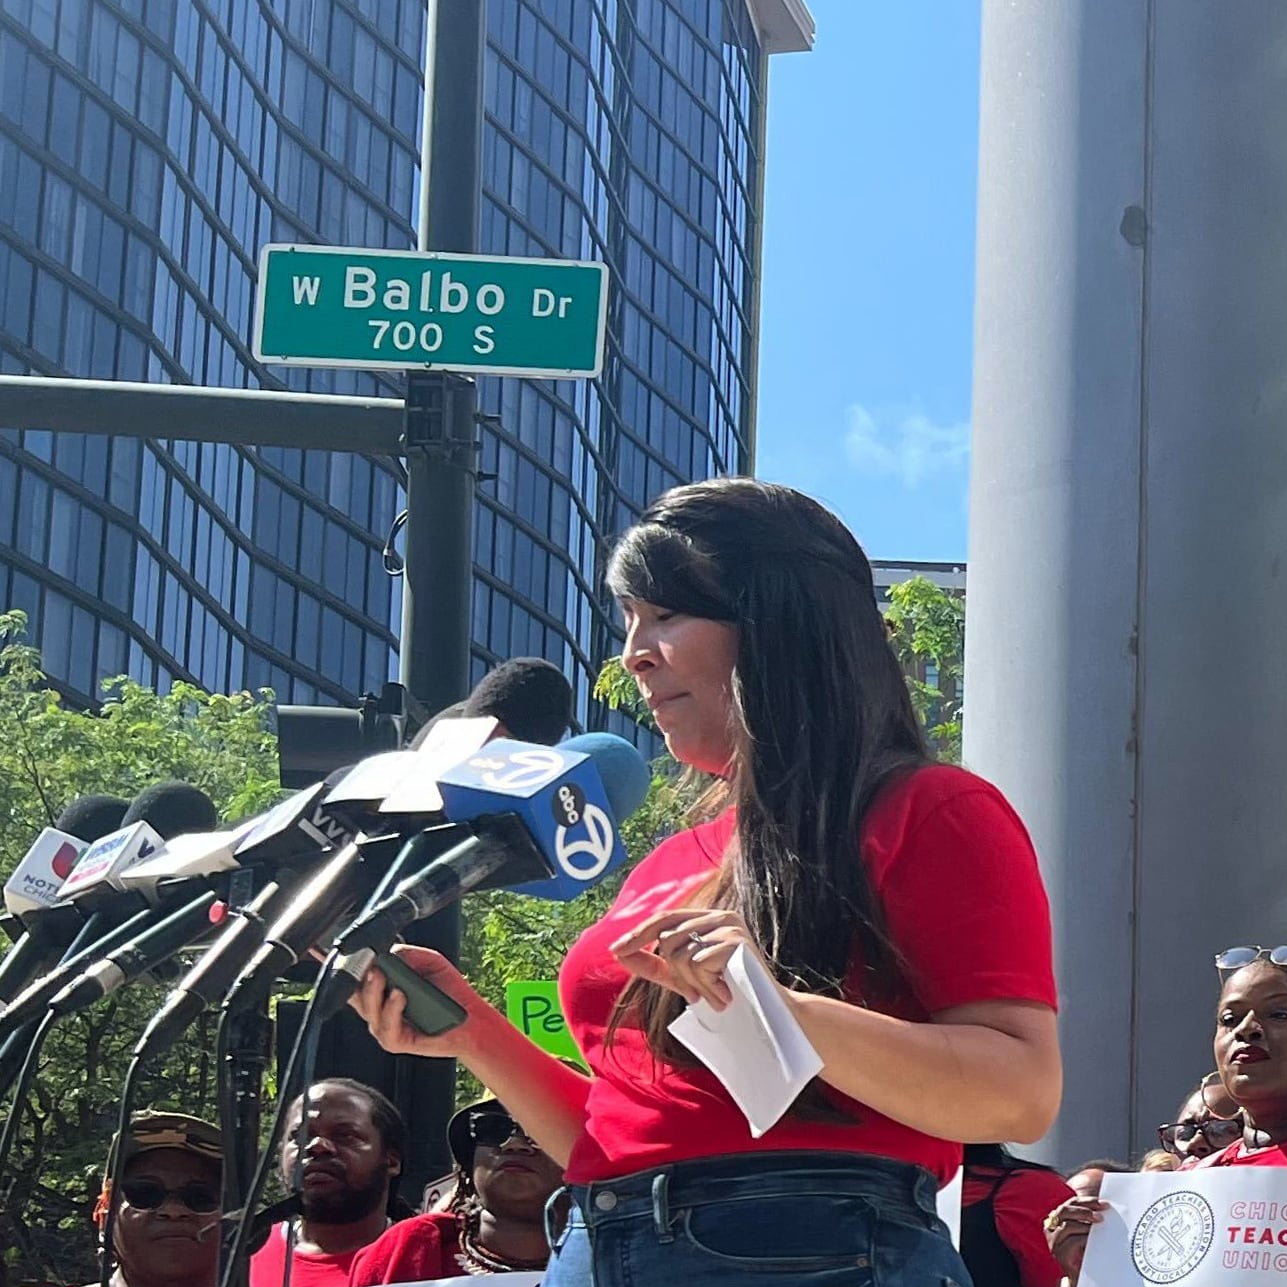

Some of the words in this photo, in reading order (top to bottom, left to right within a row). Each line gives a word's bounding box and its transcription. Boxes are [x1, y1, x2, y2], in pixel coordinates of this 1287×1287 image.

[292, 275, 321, 306] W
[343, 265, 505, 316] Balbo
[531, 288, 573, 319] Dr
[368, 319, 444, 352] 700
[473, 325, 496, 354] S
[558, 786, 580, 824] abc
[555, 803, 614, 881] 7
[1199, 1215, 1211, 1252] UNION
